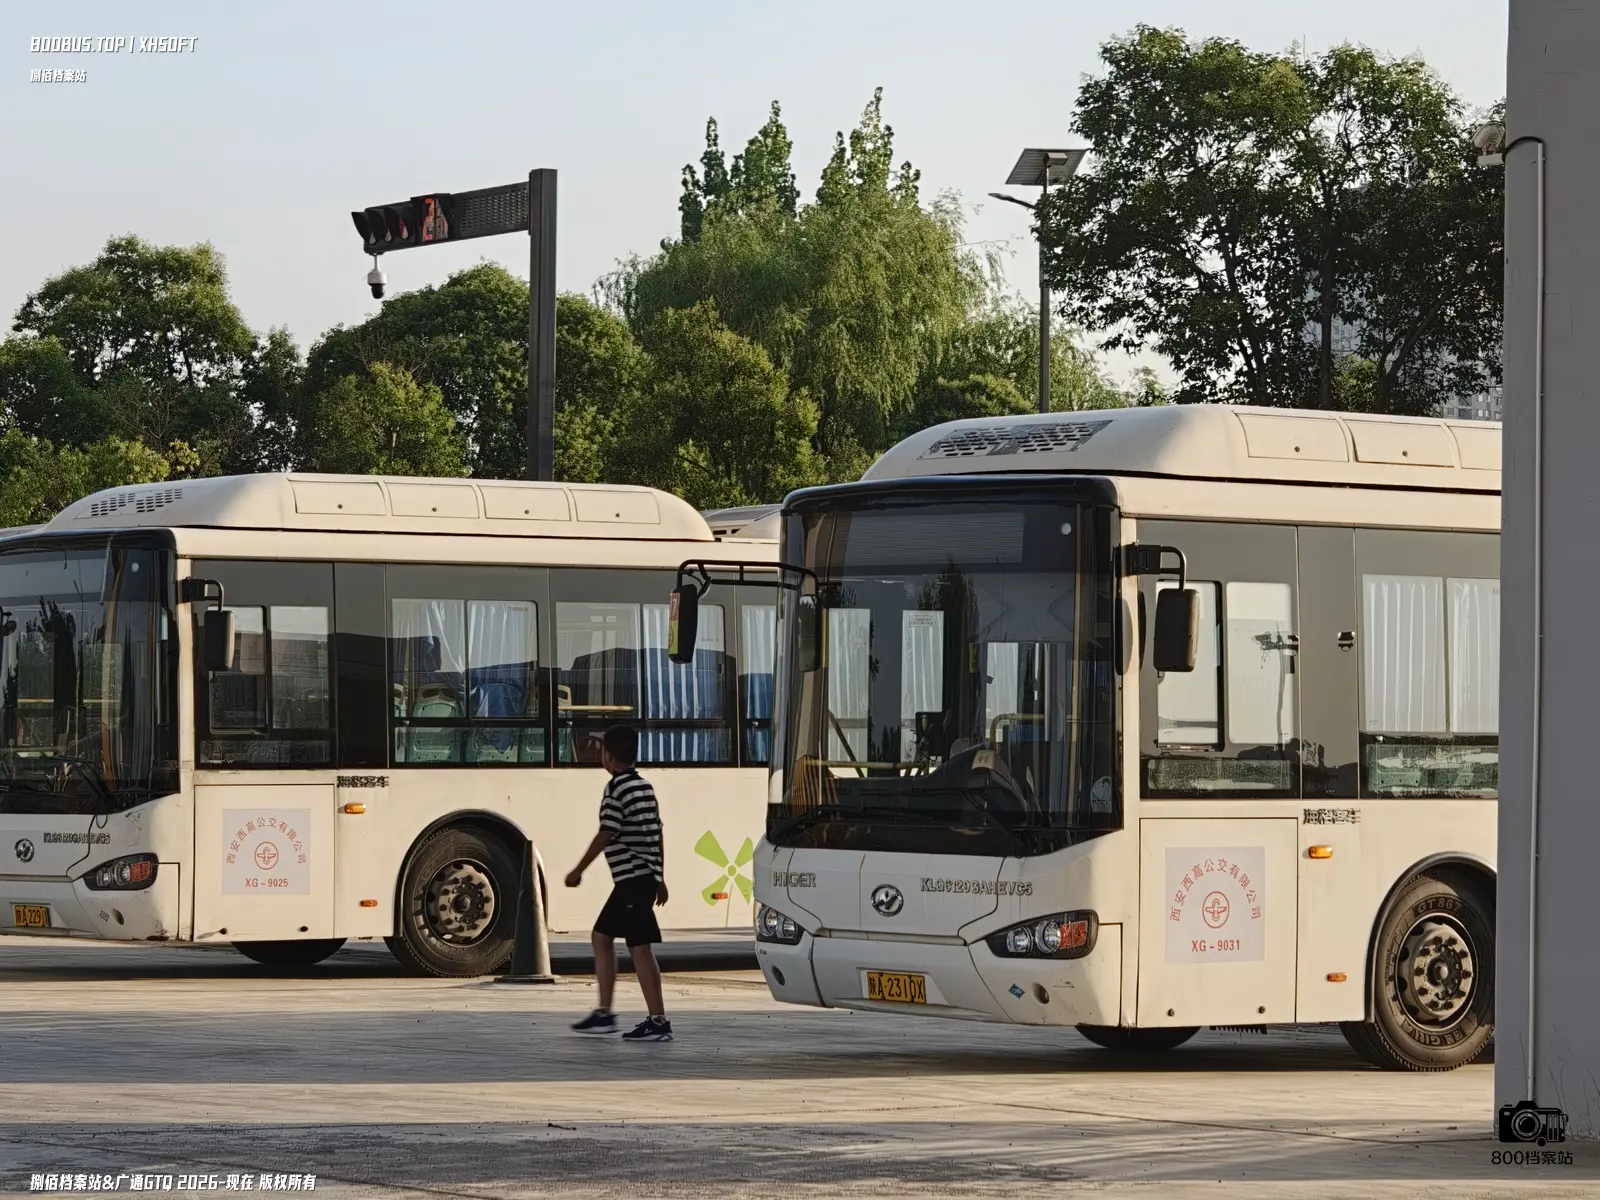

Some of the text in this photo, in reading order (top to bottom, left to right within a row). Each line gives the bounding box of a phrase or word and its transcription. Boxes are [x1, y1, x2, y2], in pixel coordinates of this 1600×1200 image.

[226, 817, 307, 864] 西安西高公交有限公司
[773, 871, 817, 888] HIGER
[1170, 858, 1261, 921] 西安西高公交有限公司
[1438, 898, 1462, 912] 867
